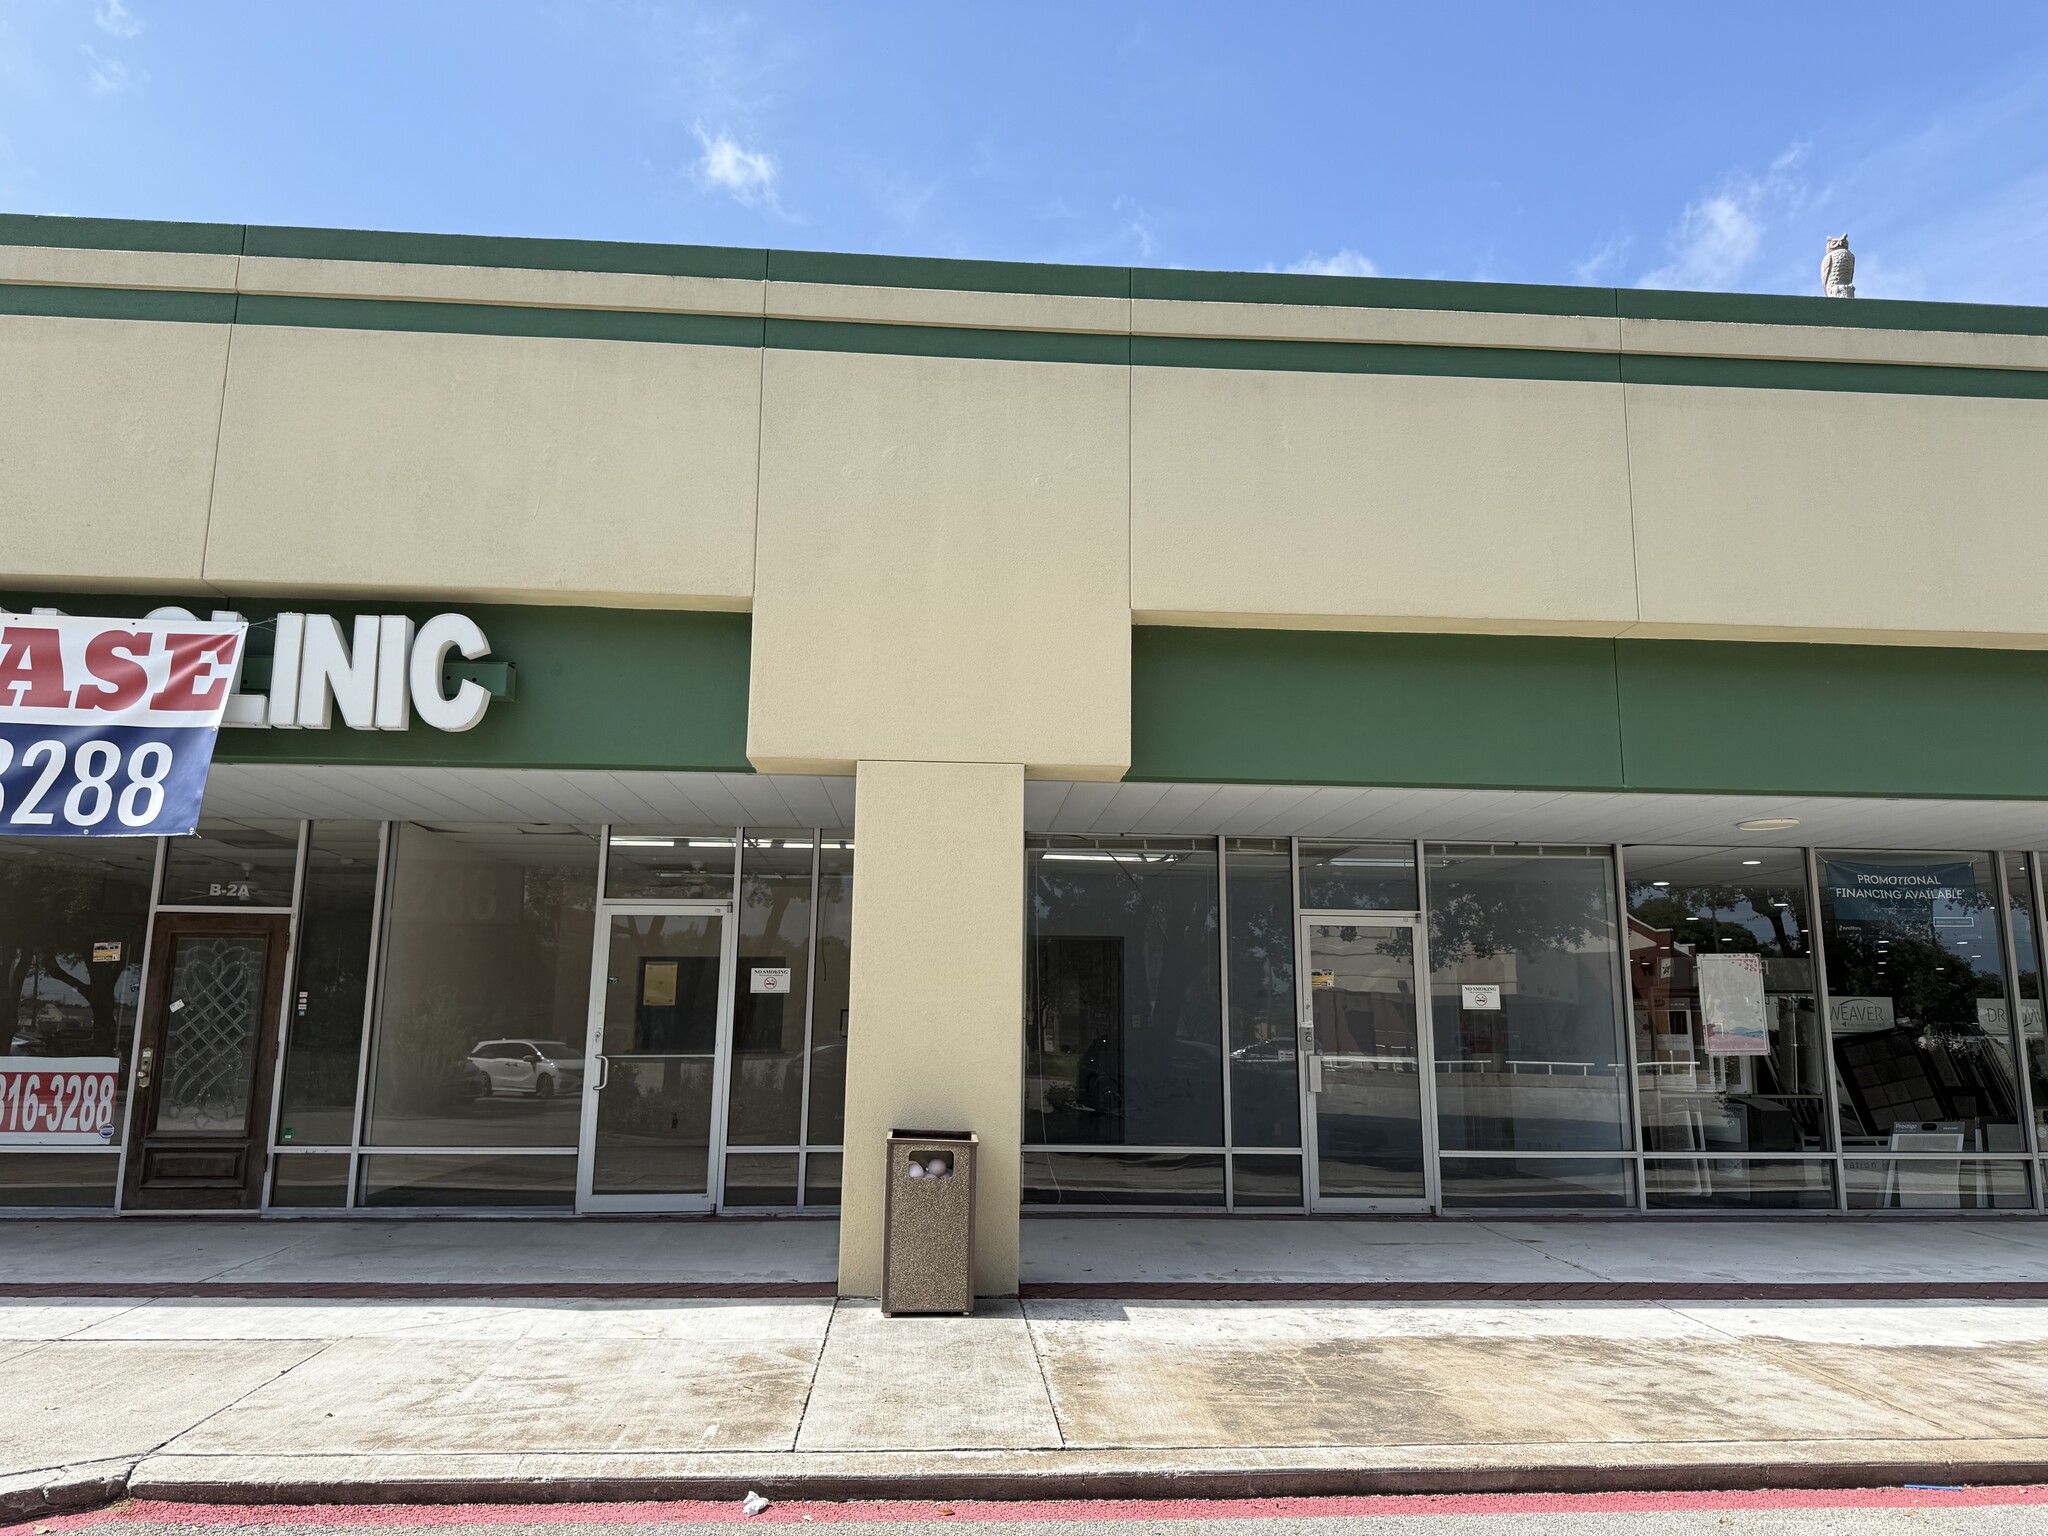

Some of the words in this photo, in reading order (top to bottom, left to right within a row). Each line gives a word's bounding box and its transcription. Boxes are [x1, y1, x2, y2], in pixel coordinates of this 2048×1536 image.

[0, 626, 239, 712] ASE
[1856, 874, 1942, 886] PROMOTIONAL
[209, 883, 250, 897] B-2A
[1836, 888, 1902, 900] FINANCING
